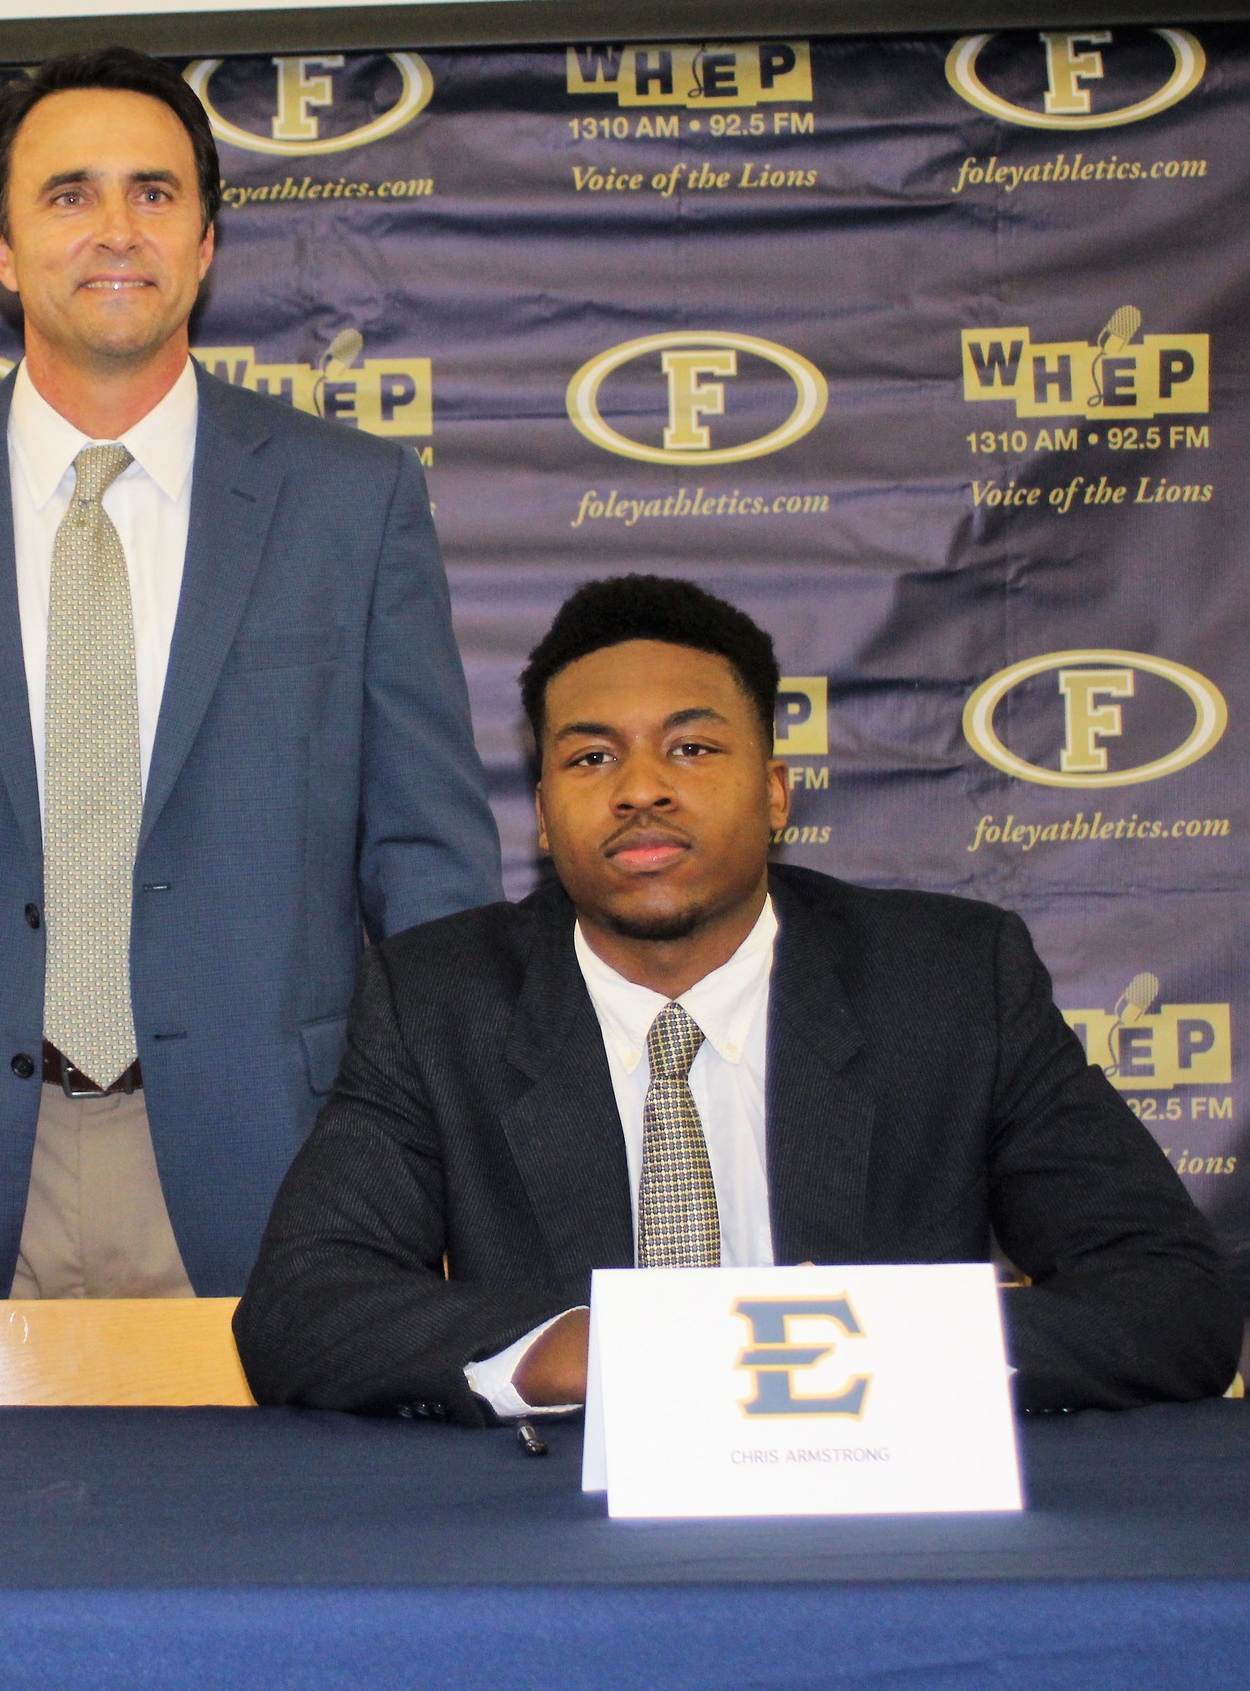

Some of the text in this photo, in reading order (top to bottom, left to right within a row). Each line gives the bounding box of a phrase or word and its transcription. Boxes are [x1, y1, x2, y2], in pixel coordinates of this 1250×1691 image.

[568, 43, 797, 98] WHEP
[1039, 31, 1114, 114] F
[271, 54, 345, 140] F
[570, 112, 814, 138] 1310 AM 92.5 FM
[574, 164, 817, 197] Voice of the Lions
[952, 154, 1207, 192] foleyathletics.com
[221, 177, 434, 208] eyathletics.com
[968, 339, 1195, 406] WHEP
[660, 348, 738, 451] F
[968, 426, 1210, 452] 1310 AM 92.5 FM
[572, 487, 829, 528] foleyathletics.com
[973, 477, 1214, 512] Voice of the Lions
[1057, 668, 1135, 773] F
[788, 767, 829, 790] FM
[771, 826, 831, 845] ions
[968, 812, 1230, 852] foleyathletics.com
[1192, 1098, 1233, 1119] FM
[1164, 1149, 1237, 1175] ions
[729, 1290, 873, 1421] E
[730, 1447, 890, 1465] CHRIS ARMSTRONG
